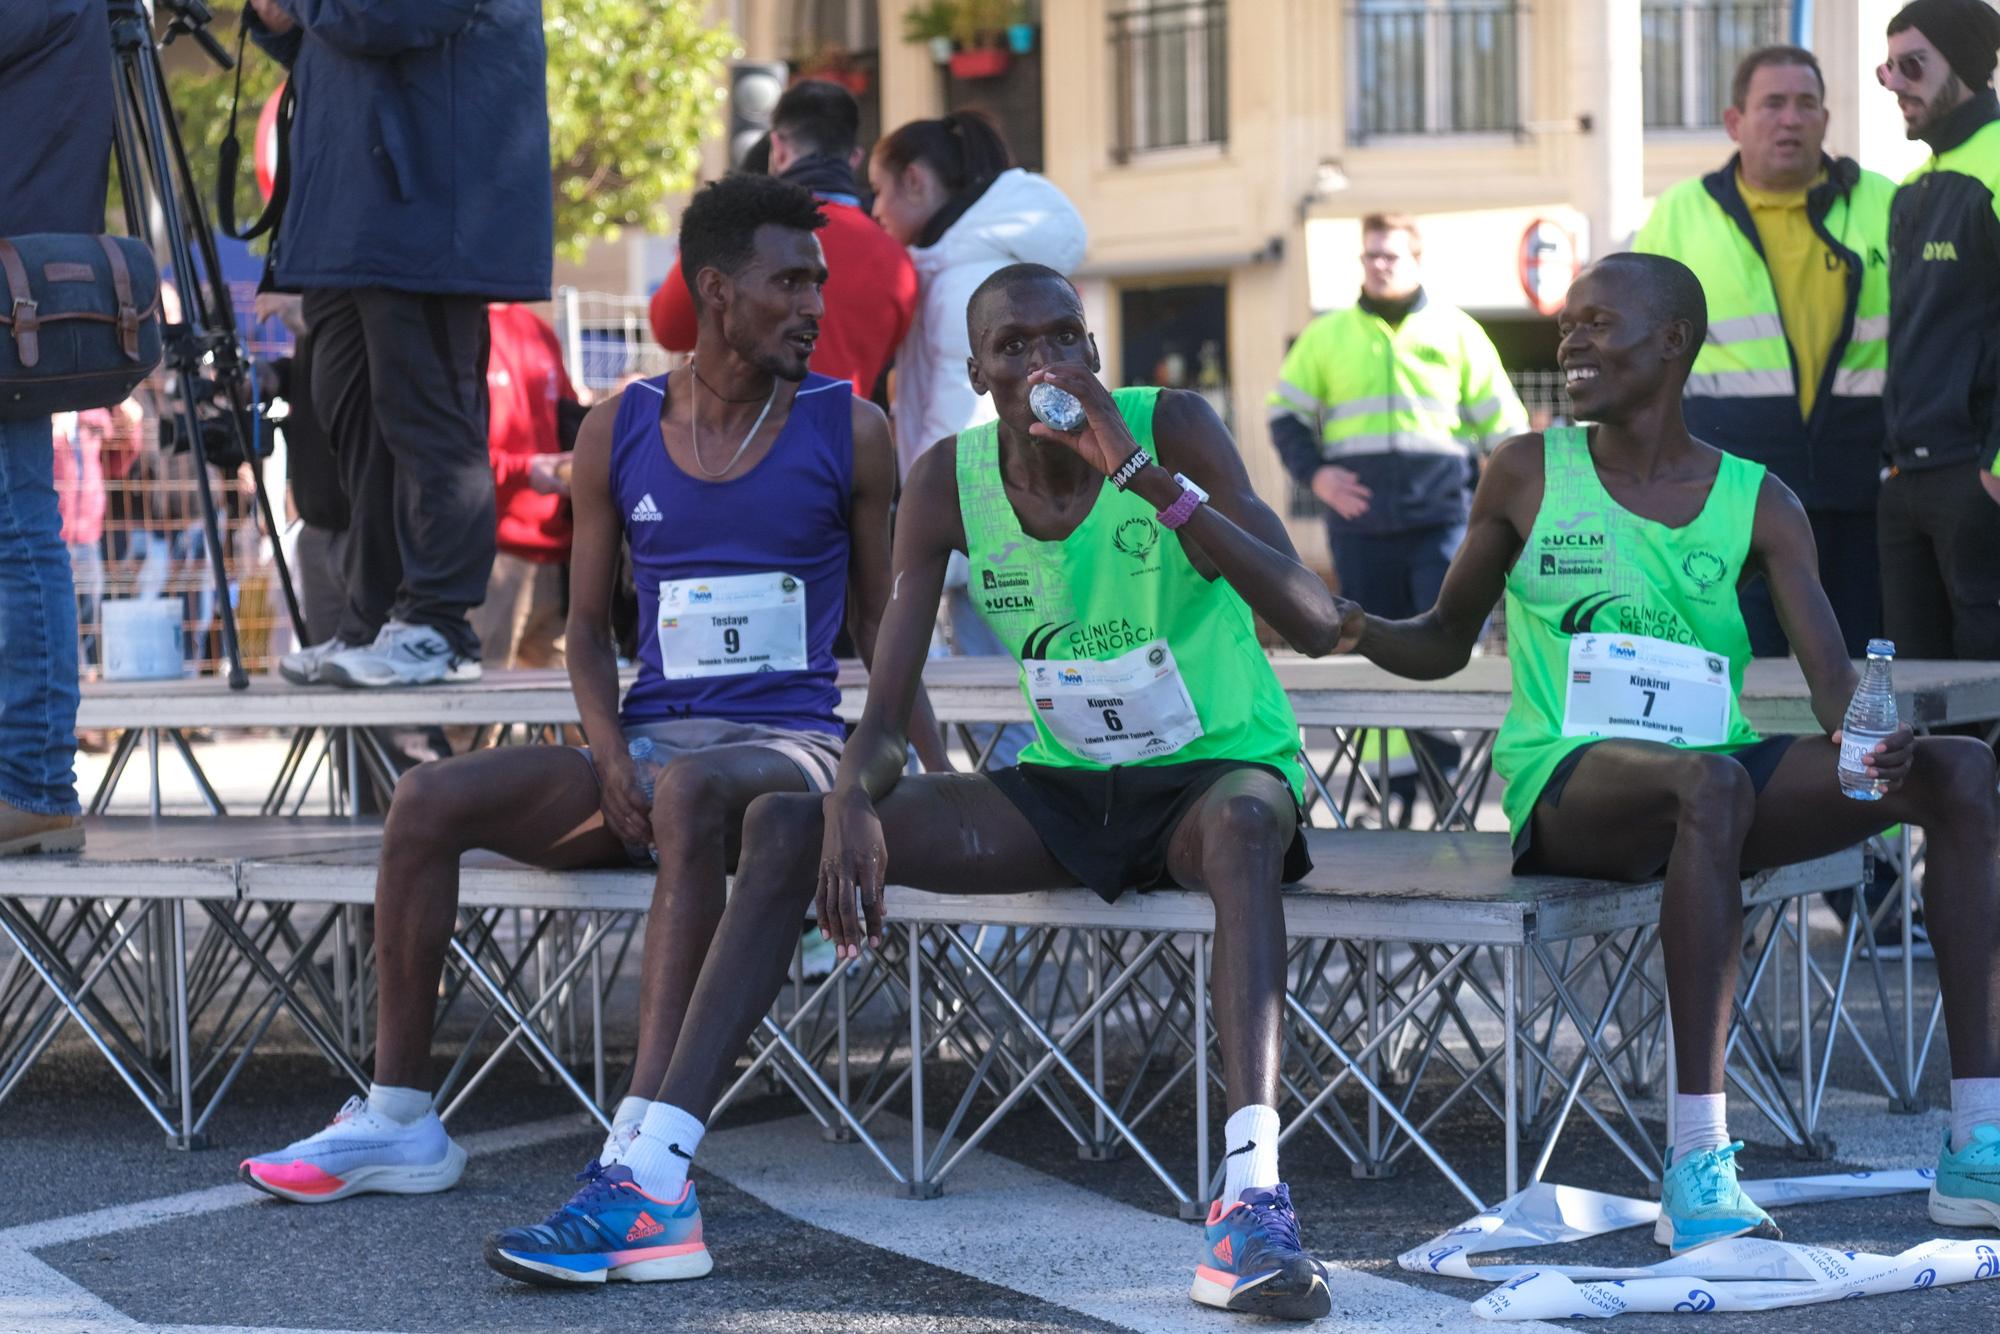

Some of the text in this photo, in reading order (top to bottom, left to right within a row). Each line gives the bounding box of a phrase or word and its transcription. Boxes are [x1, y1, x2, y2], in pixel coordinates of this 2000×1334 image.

[631, 511, 664, 522] adidas
[1553, 535, 1604, 546] UCLM
[993, 596, 1034, 609] UCLM
[723, 628, 740, 654] 9
[1629, 674, 1670, 691] Kipkirui
[1086, 697, 1124, 710] Kipruto
[1642, 690, 1656, 718] 7
[1102, 709, 1124, 732] 6
[626, 1223, 665, 1242] adidas
[1808, 1254, 1839, 1281] ALICANT
[1583, 1282, 1628, 1309] UTACIÓN
